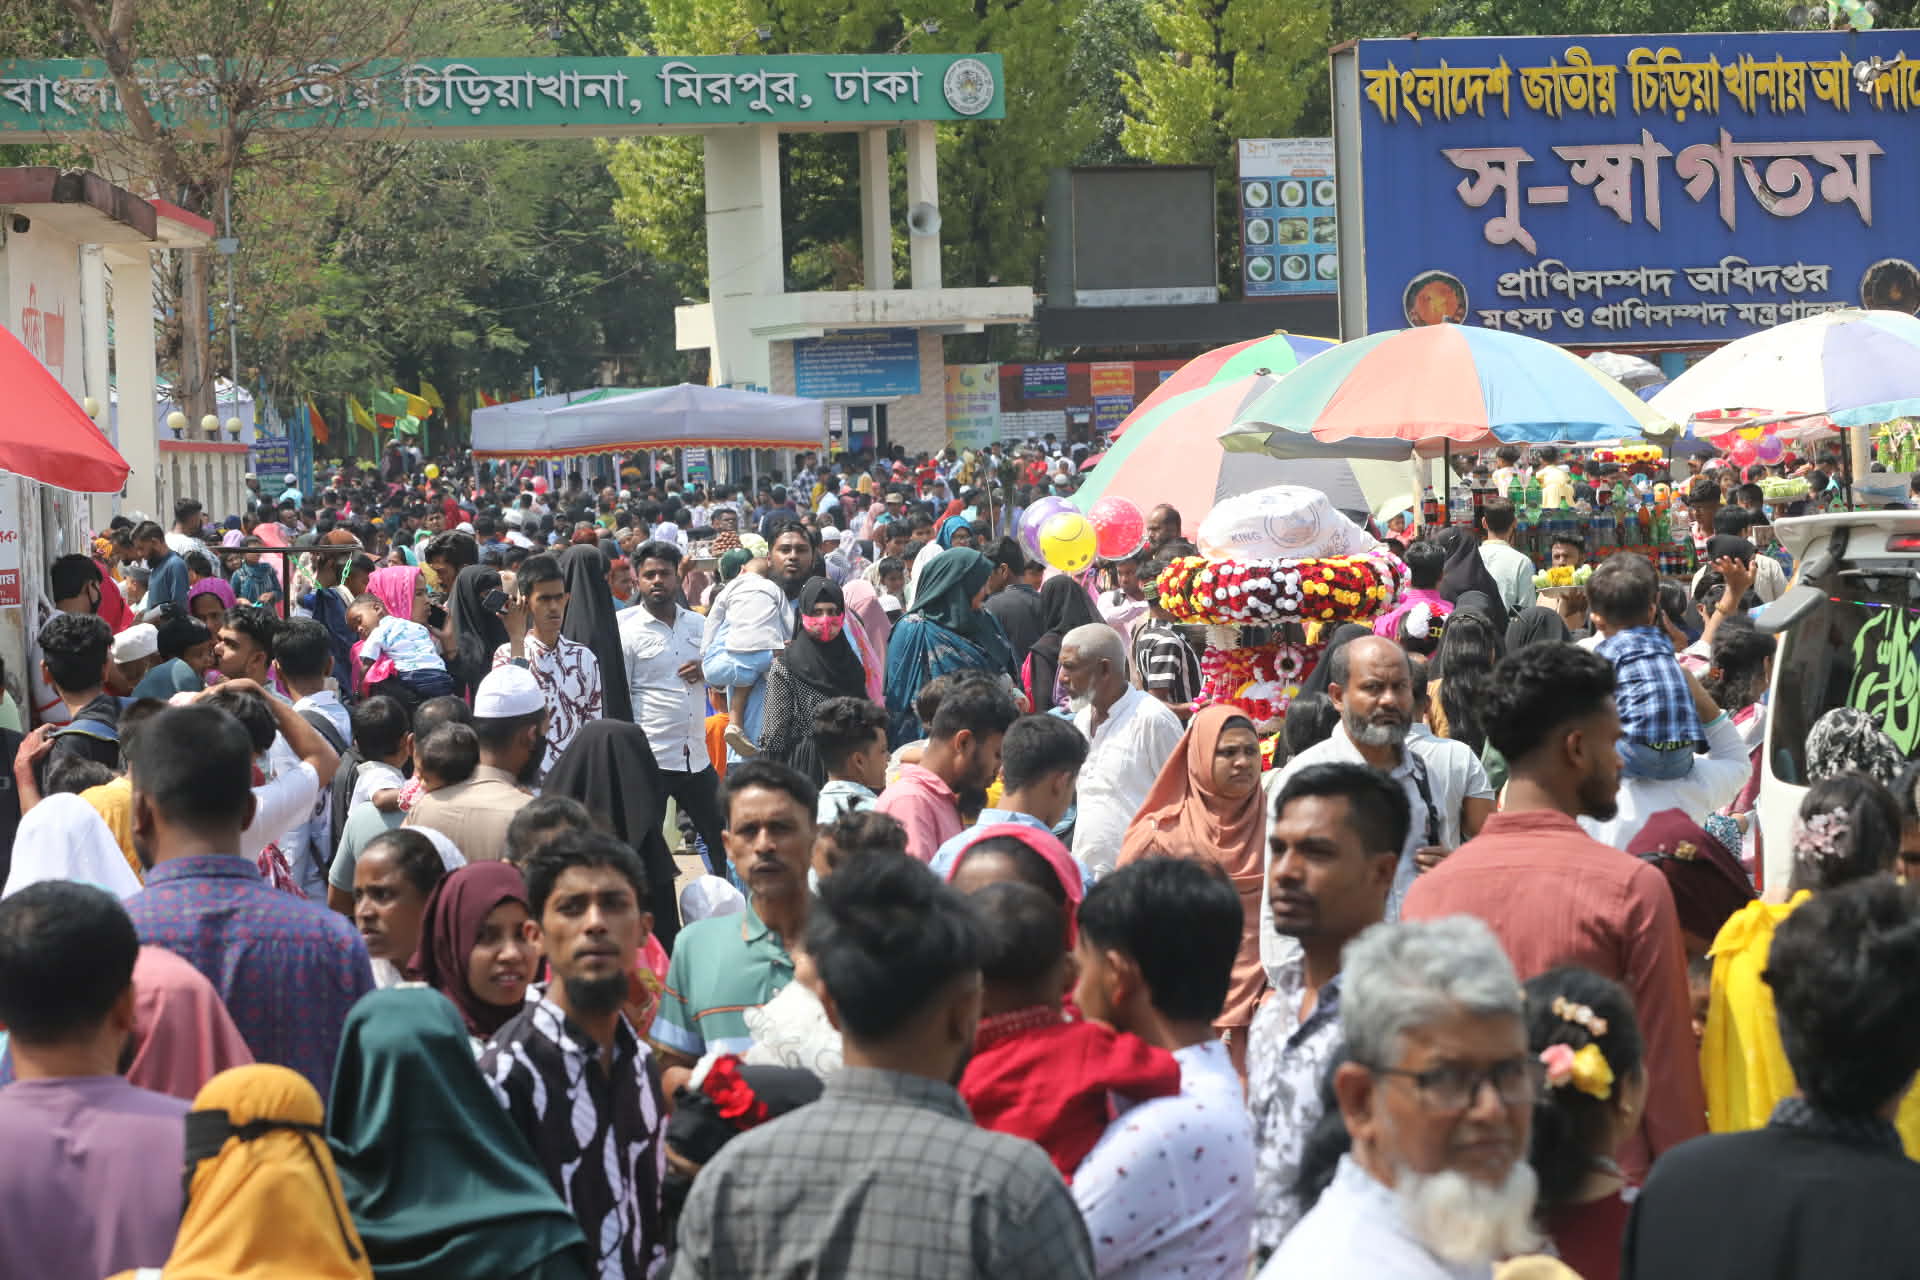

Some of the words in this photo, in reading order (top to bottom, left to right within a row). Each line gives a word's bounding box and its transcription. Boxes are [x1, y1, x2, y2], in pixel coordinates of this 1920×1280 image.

[400, 63, 642, 115] চিড়িয়াখানা,
[656, 61, 812, 114] মিরপুর,
[826, 66, 924, 105] ঢাকা
[1360, 56, 1510, 126] বাংলাদেশ
[1519, 46, 1619, 120] জাতীয়
[1497, 258, 1677, 301] প্রাণিসম্পদ
[1682, 255, 1832, 301] অধিদপ্তর
[1476, 308, 1557, 332] মৎস্য
[1561, 308, 1586, 329] ও
[1590, 298, 1729, 330] প্রাণিসম্পদ
